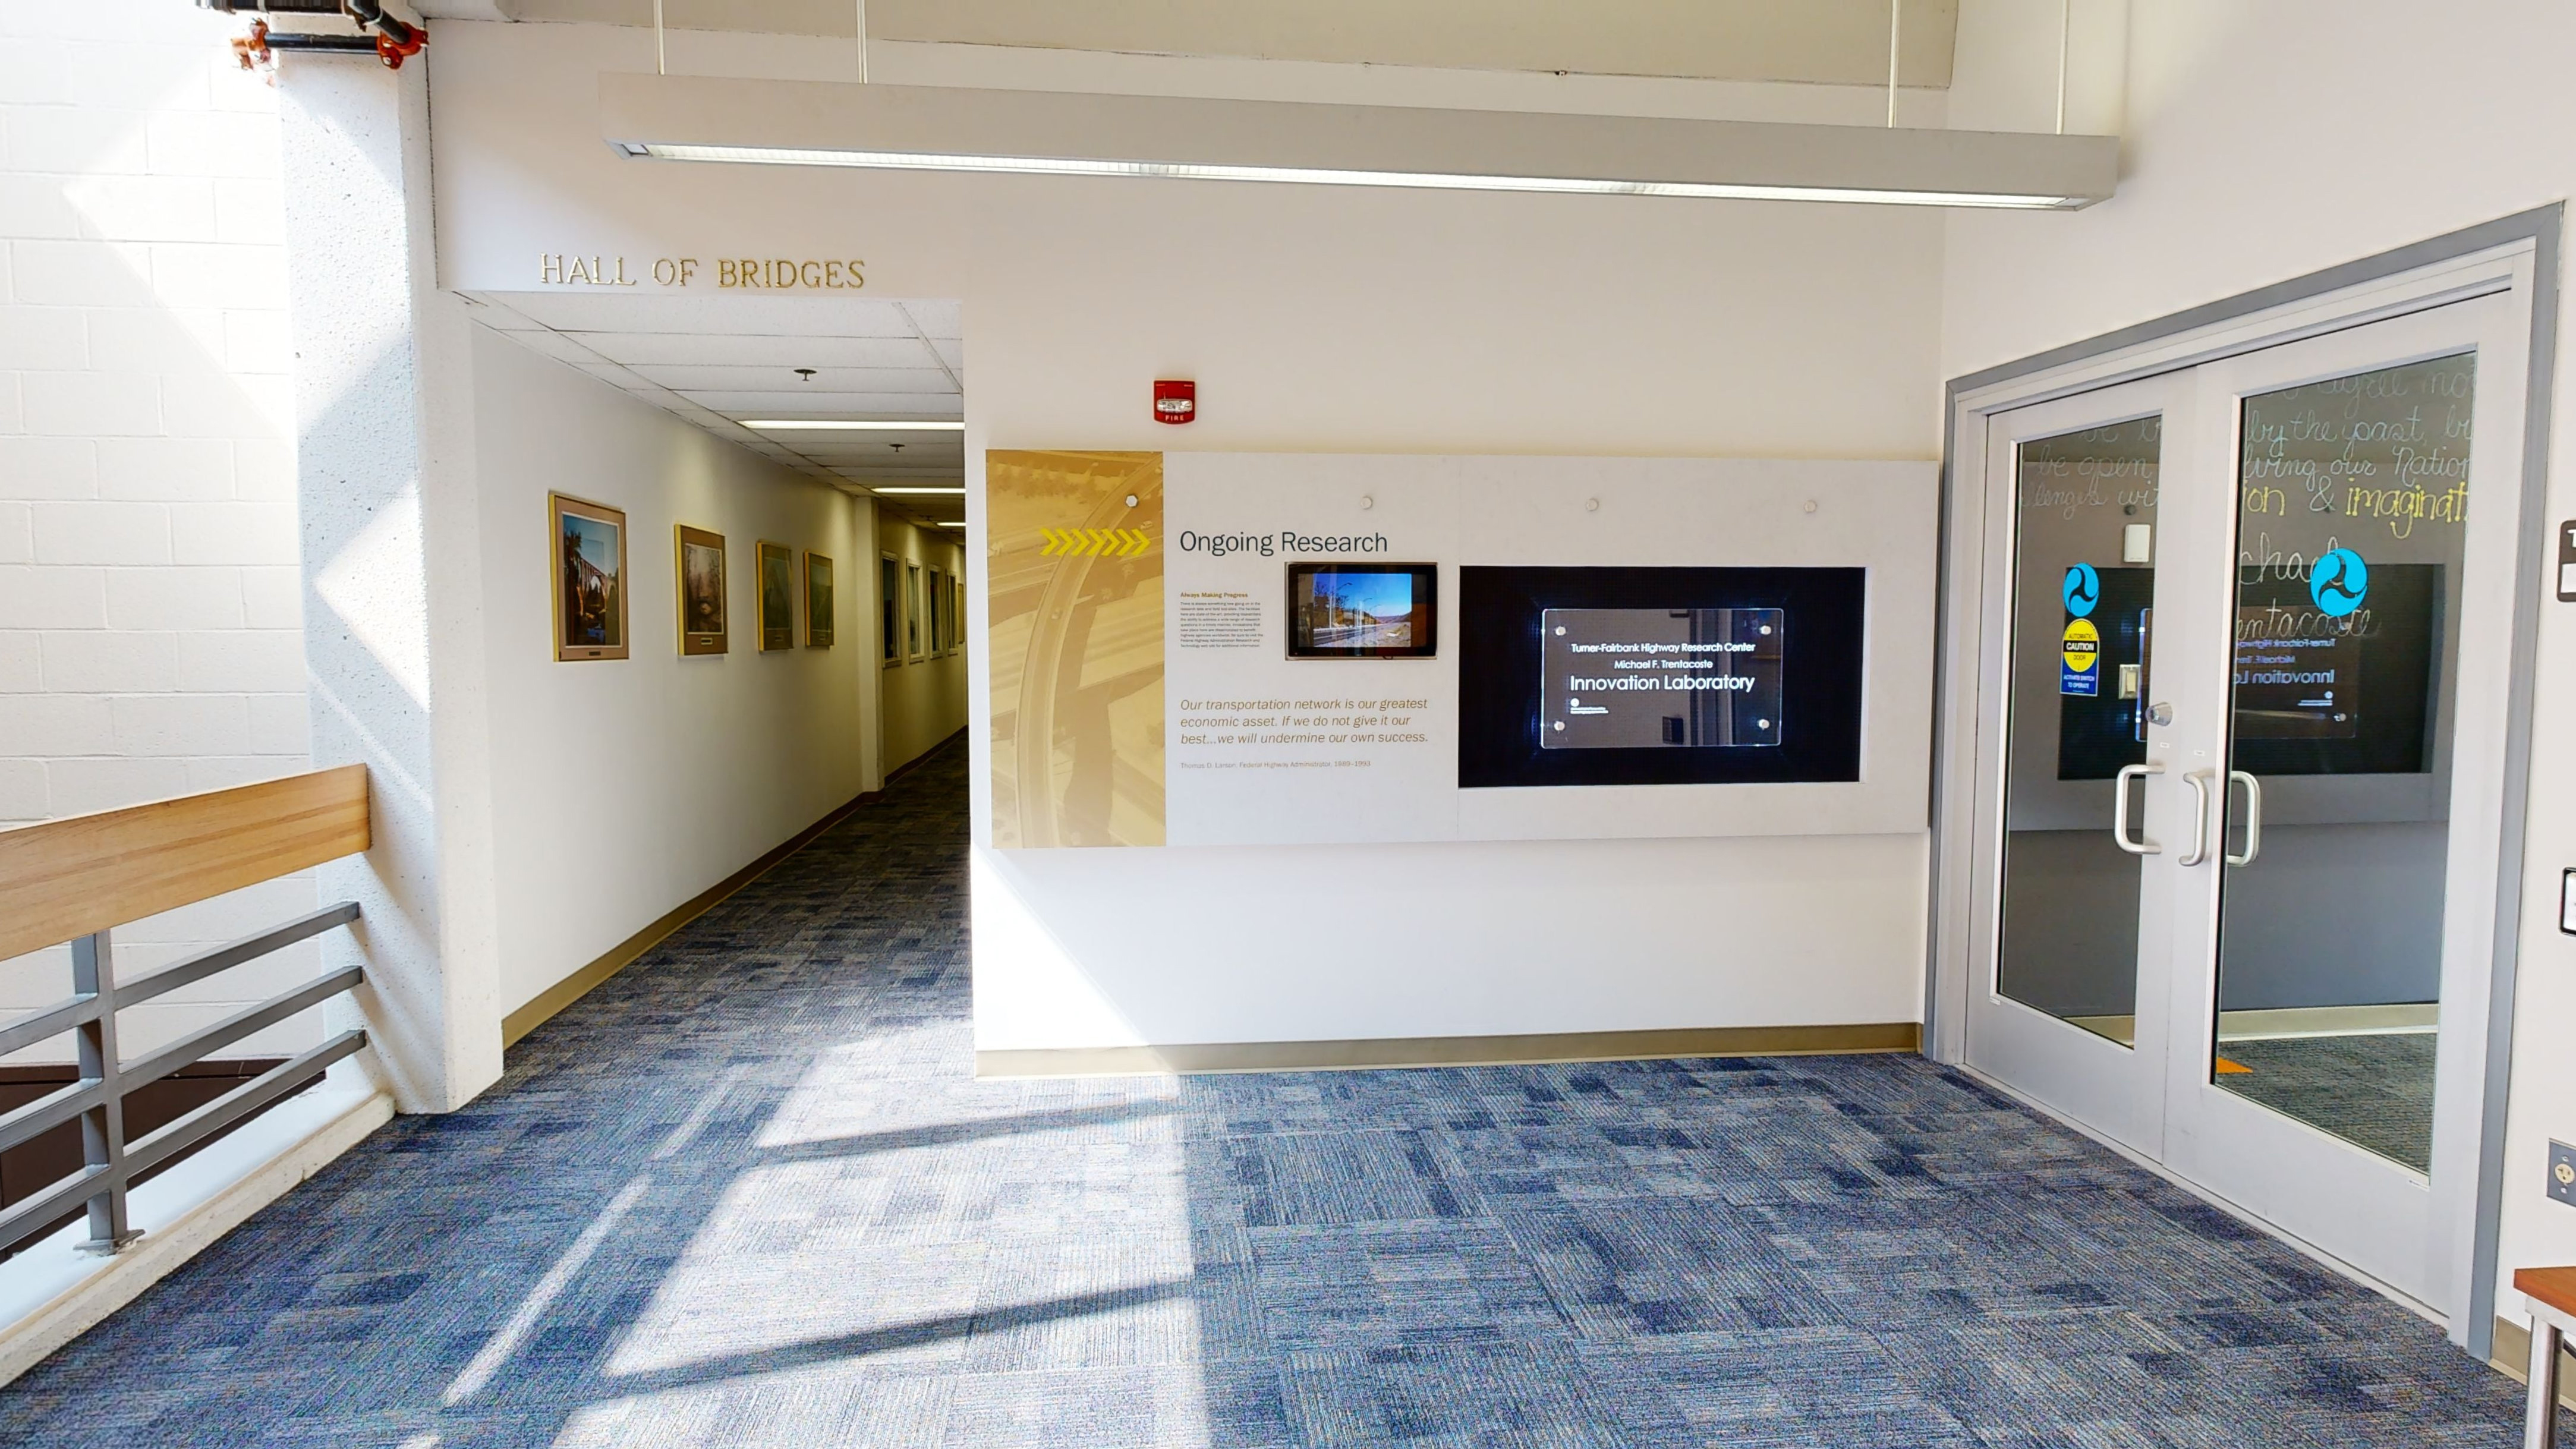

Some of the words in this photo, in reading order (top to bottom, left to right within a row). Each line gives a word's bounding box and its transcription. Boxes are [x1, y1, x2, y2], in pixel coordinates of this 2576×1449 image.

[540, 253, 637, 285] HALL
[652, 258, 698, 286] OF
[717, 259, 865, 289] BRIDGES
[2291, 410, 2337, 443] the
[2345, 477, 2468, 539] imaginat
[1180, 530, 1274, 556] Ongoing
[1281, 531, 1388, 553] Research
[1571, 642, 1639, 653] Turner-Fairbank
[1641, 642, 1680, 654] Highway
[1681, 643, 1722, 653] Research
[1724, 643, 1756, 653] Center
[2066, 642, 2094, 651] CAUTION
[1614, 660, 1651, 669] Michael
[1652, 660, 1659, 669] F.
[1661, 660, 1713, 669] Trentacoste
[1570, 675, 1659, 691] Innovation
[1664, 675, 1755, 692] Laboratory
[1180, 700, 1203, 710] Our
[1206, 699, 1290, 711] transportation
[1295, 699, 1341, 710] network
[1345, 699, 1355, 709] is
[1358, 700, 1377, 709] our
[1379, 699, 1428, 711] greatest
[1180, 716, 1239, 727] economic
[1242, 717, 1278, 726] asset.
[1282, 716, 1291, 726] If
[1294, 718, 1310, 726] we
[1314, 716, 1328, 726] do
[1332, 716, 1350, 726] not
[1353, 715, 1377, 728] give
[1381, 715, 1388, 726] it
[1391, 717, 1411, 726] our
[1238, 732, 1257, 744] will
[1261, 732, 1325, 744] undermine
[1329, 733, 1347, 743] our
[1351, 733, 1374, 742] own
[1378, 733, 1428, 742] success.
